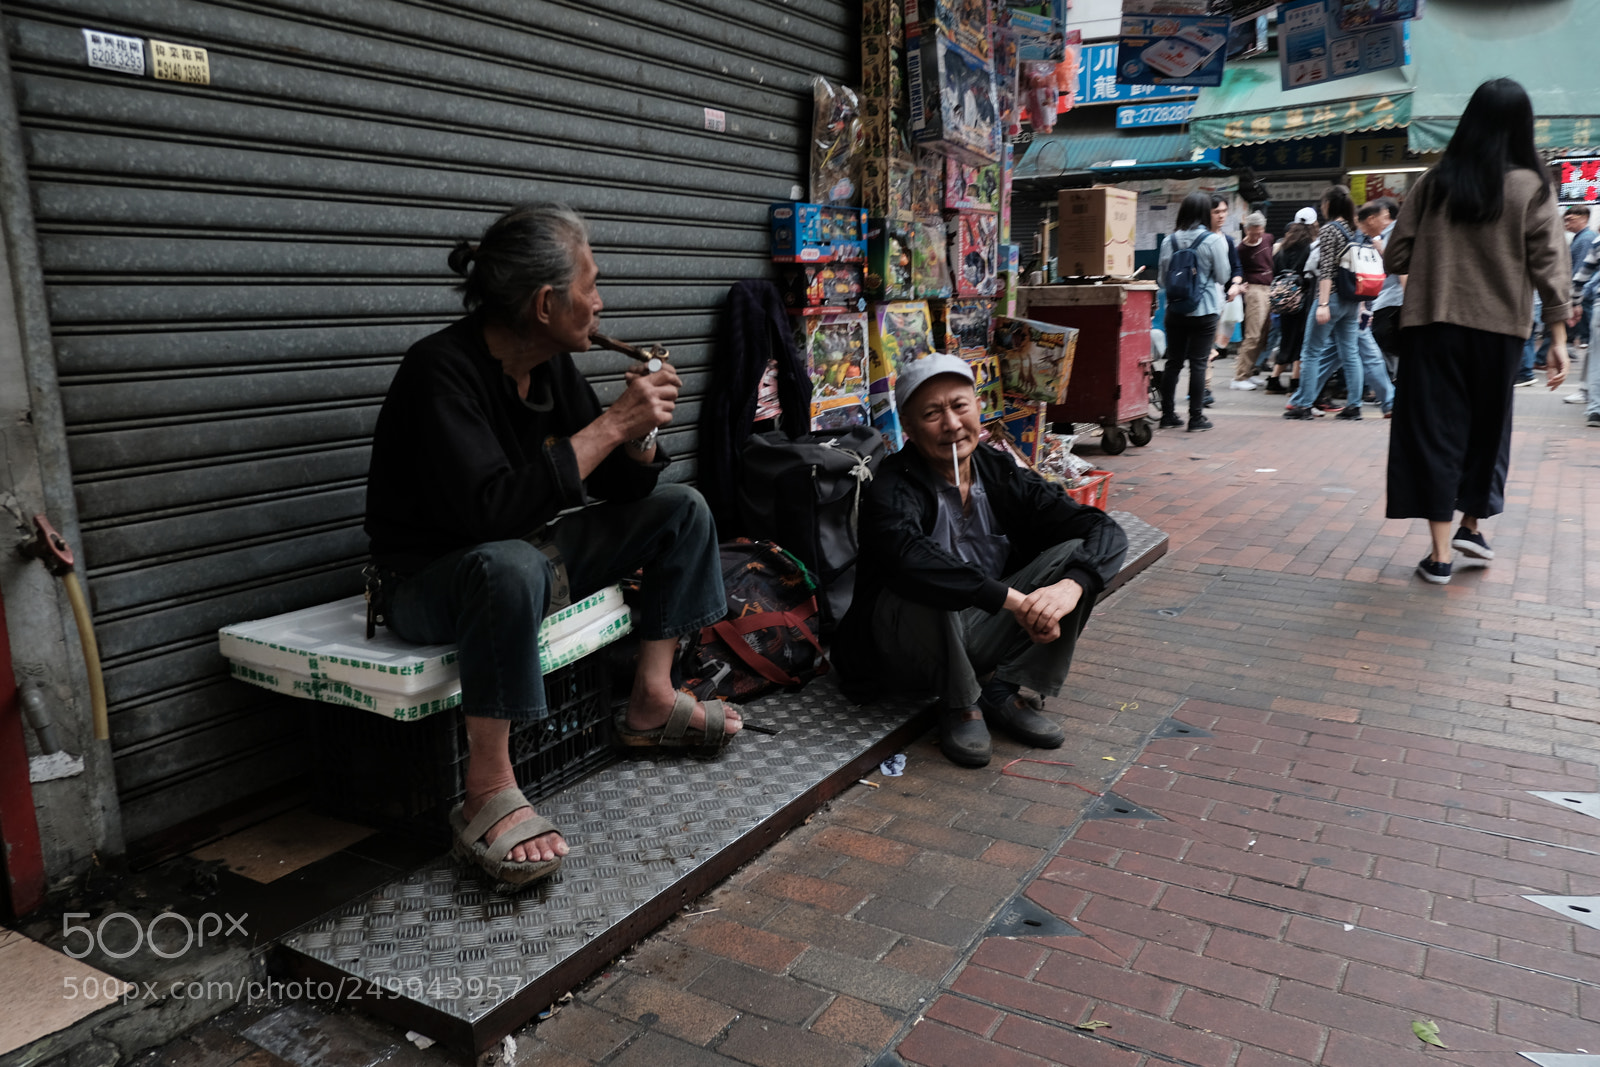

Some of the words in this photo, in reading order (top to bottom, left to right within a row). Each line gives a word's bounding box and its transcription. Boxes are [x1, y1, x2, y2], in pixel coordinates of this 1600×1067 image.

[92, 48, 116, 64] 6208
[119, 53, 143, 69] 3293
[908, 54, 924, 123] TRANSMUTATION
